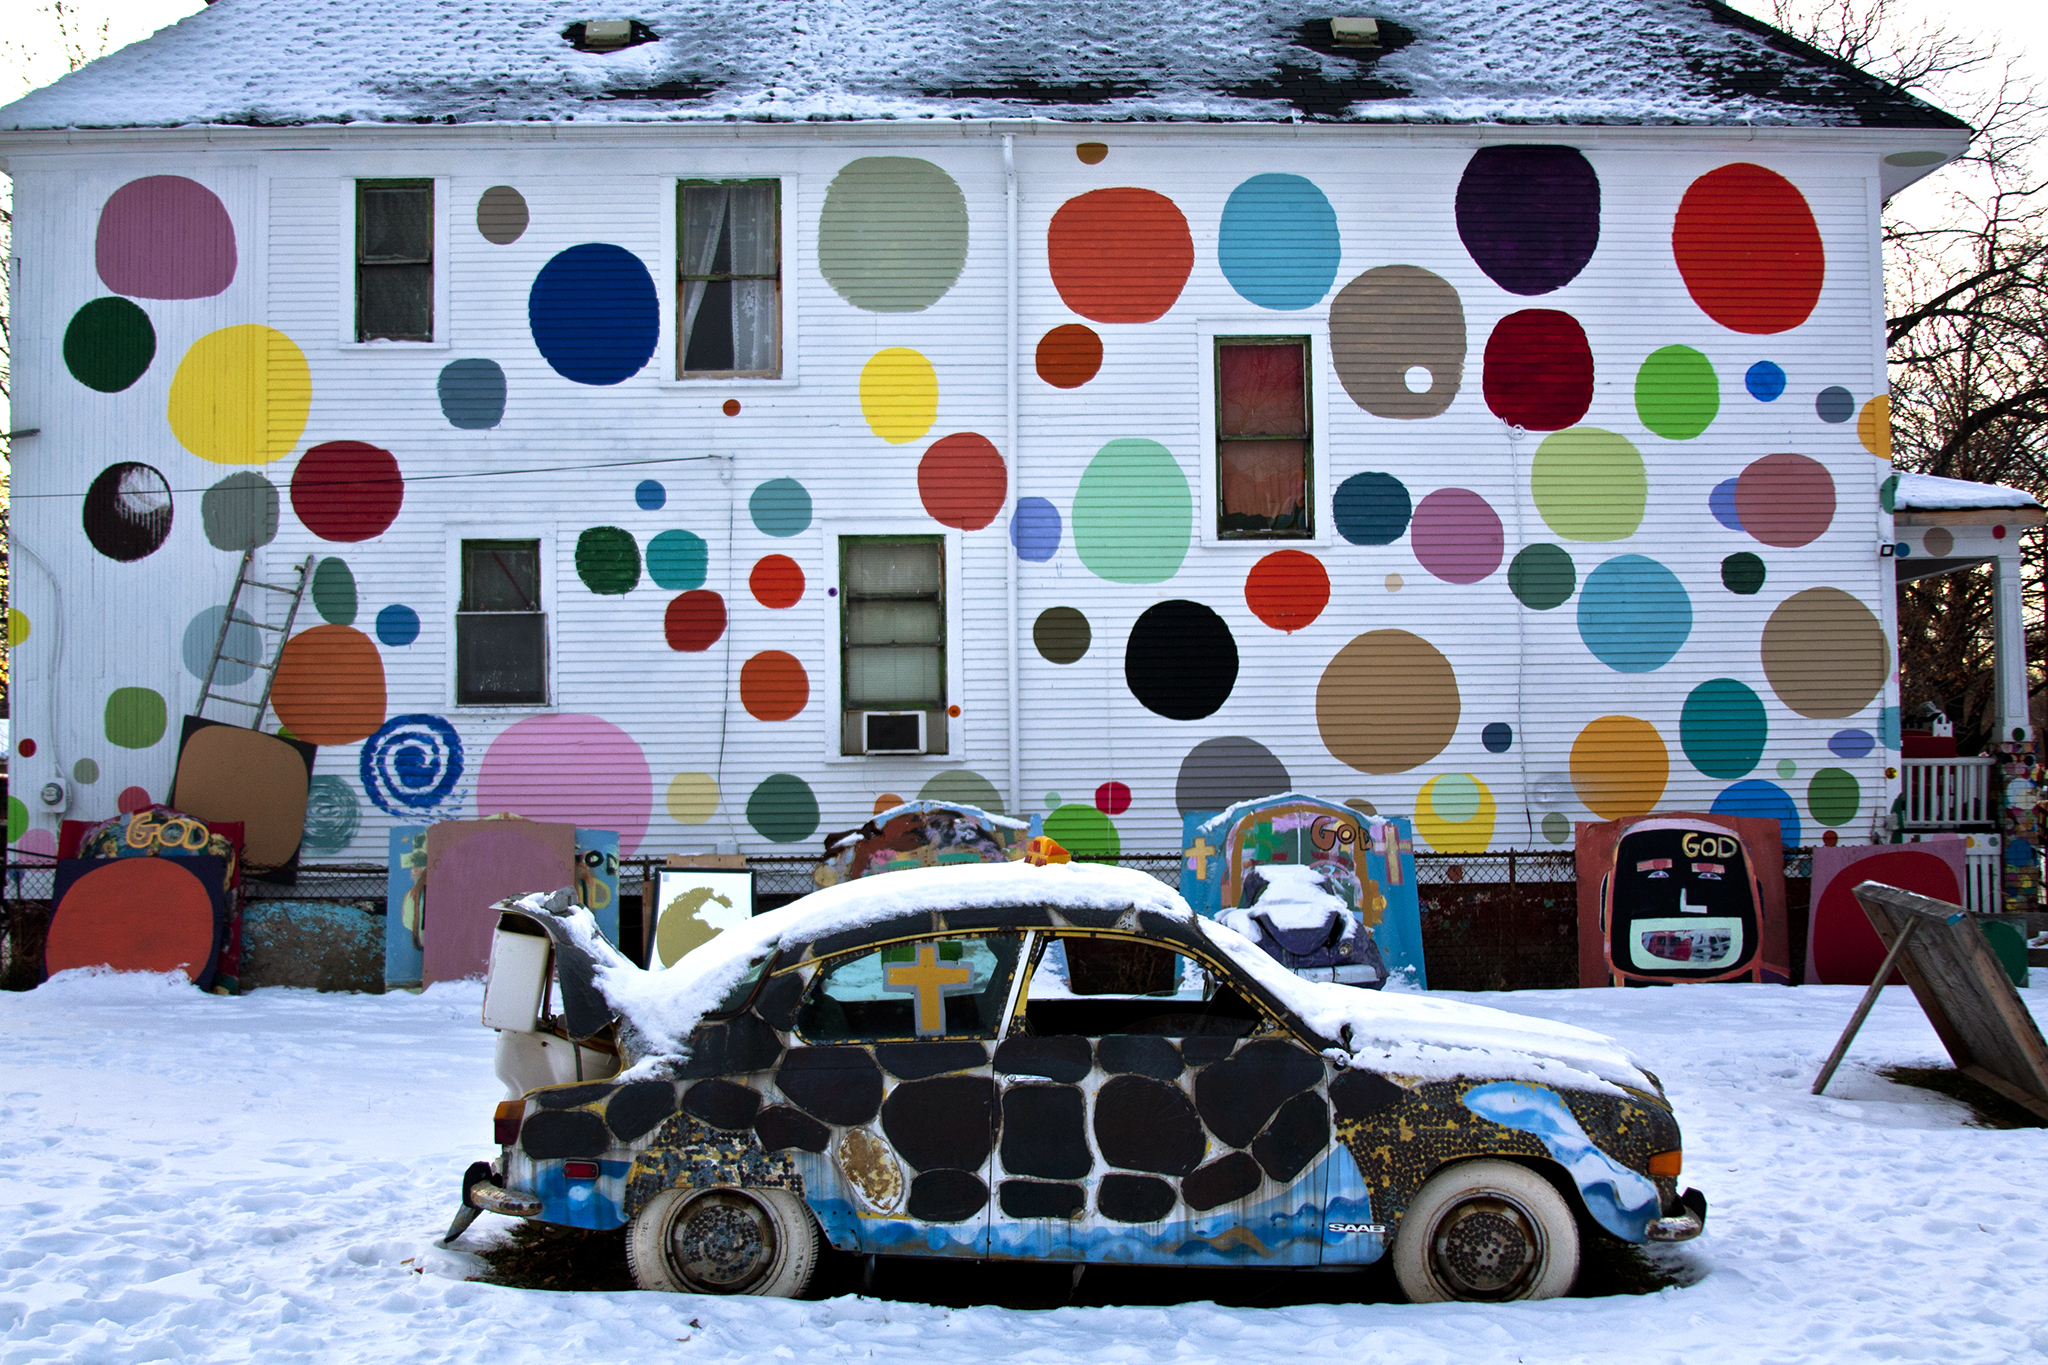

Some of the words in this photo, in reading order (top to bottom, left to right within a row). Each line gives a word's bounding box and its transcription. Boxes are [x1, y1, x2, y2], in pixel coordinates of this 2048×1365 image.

[126, 811, 209, 849] GOD
[1311, 816, 1373, 851] GOD
[1682, 833, 1737, 858] GOD
[575, 848, 618, 876] OD
[1329, 1223, 1386, 1233] SAAB
